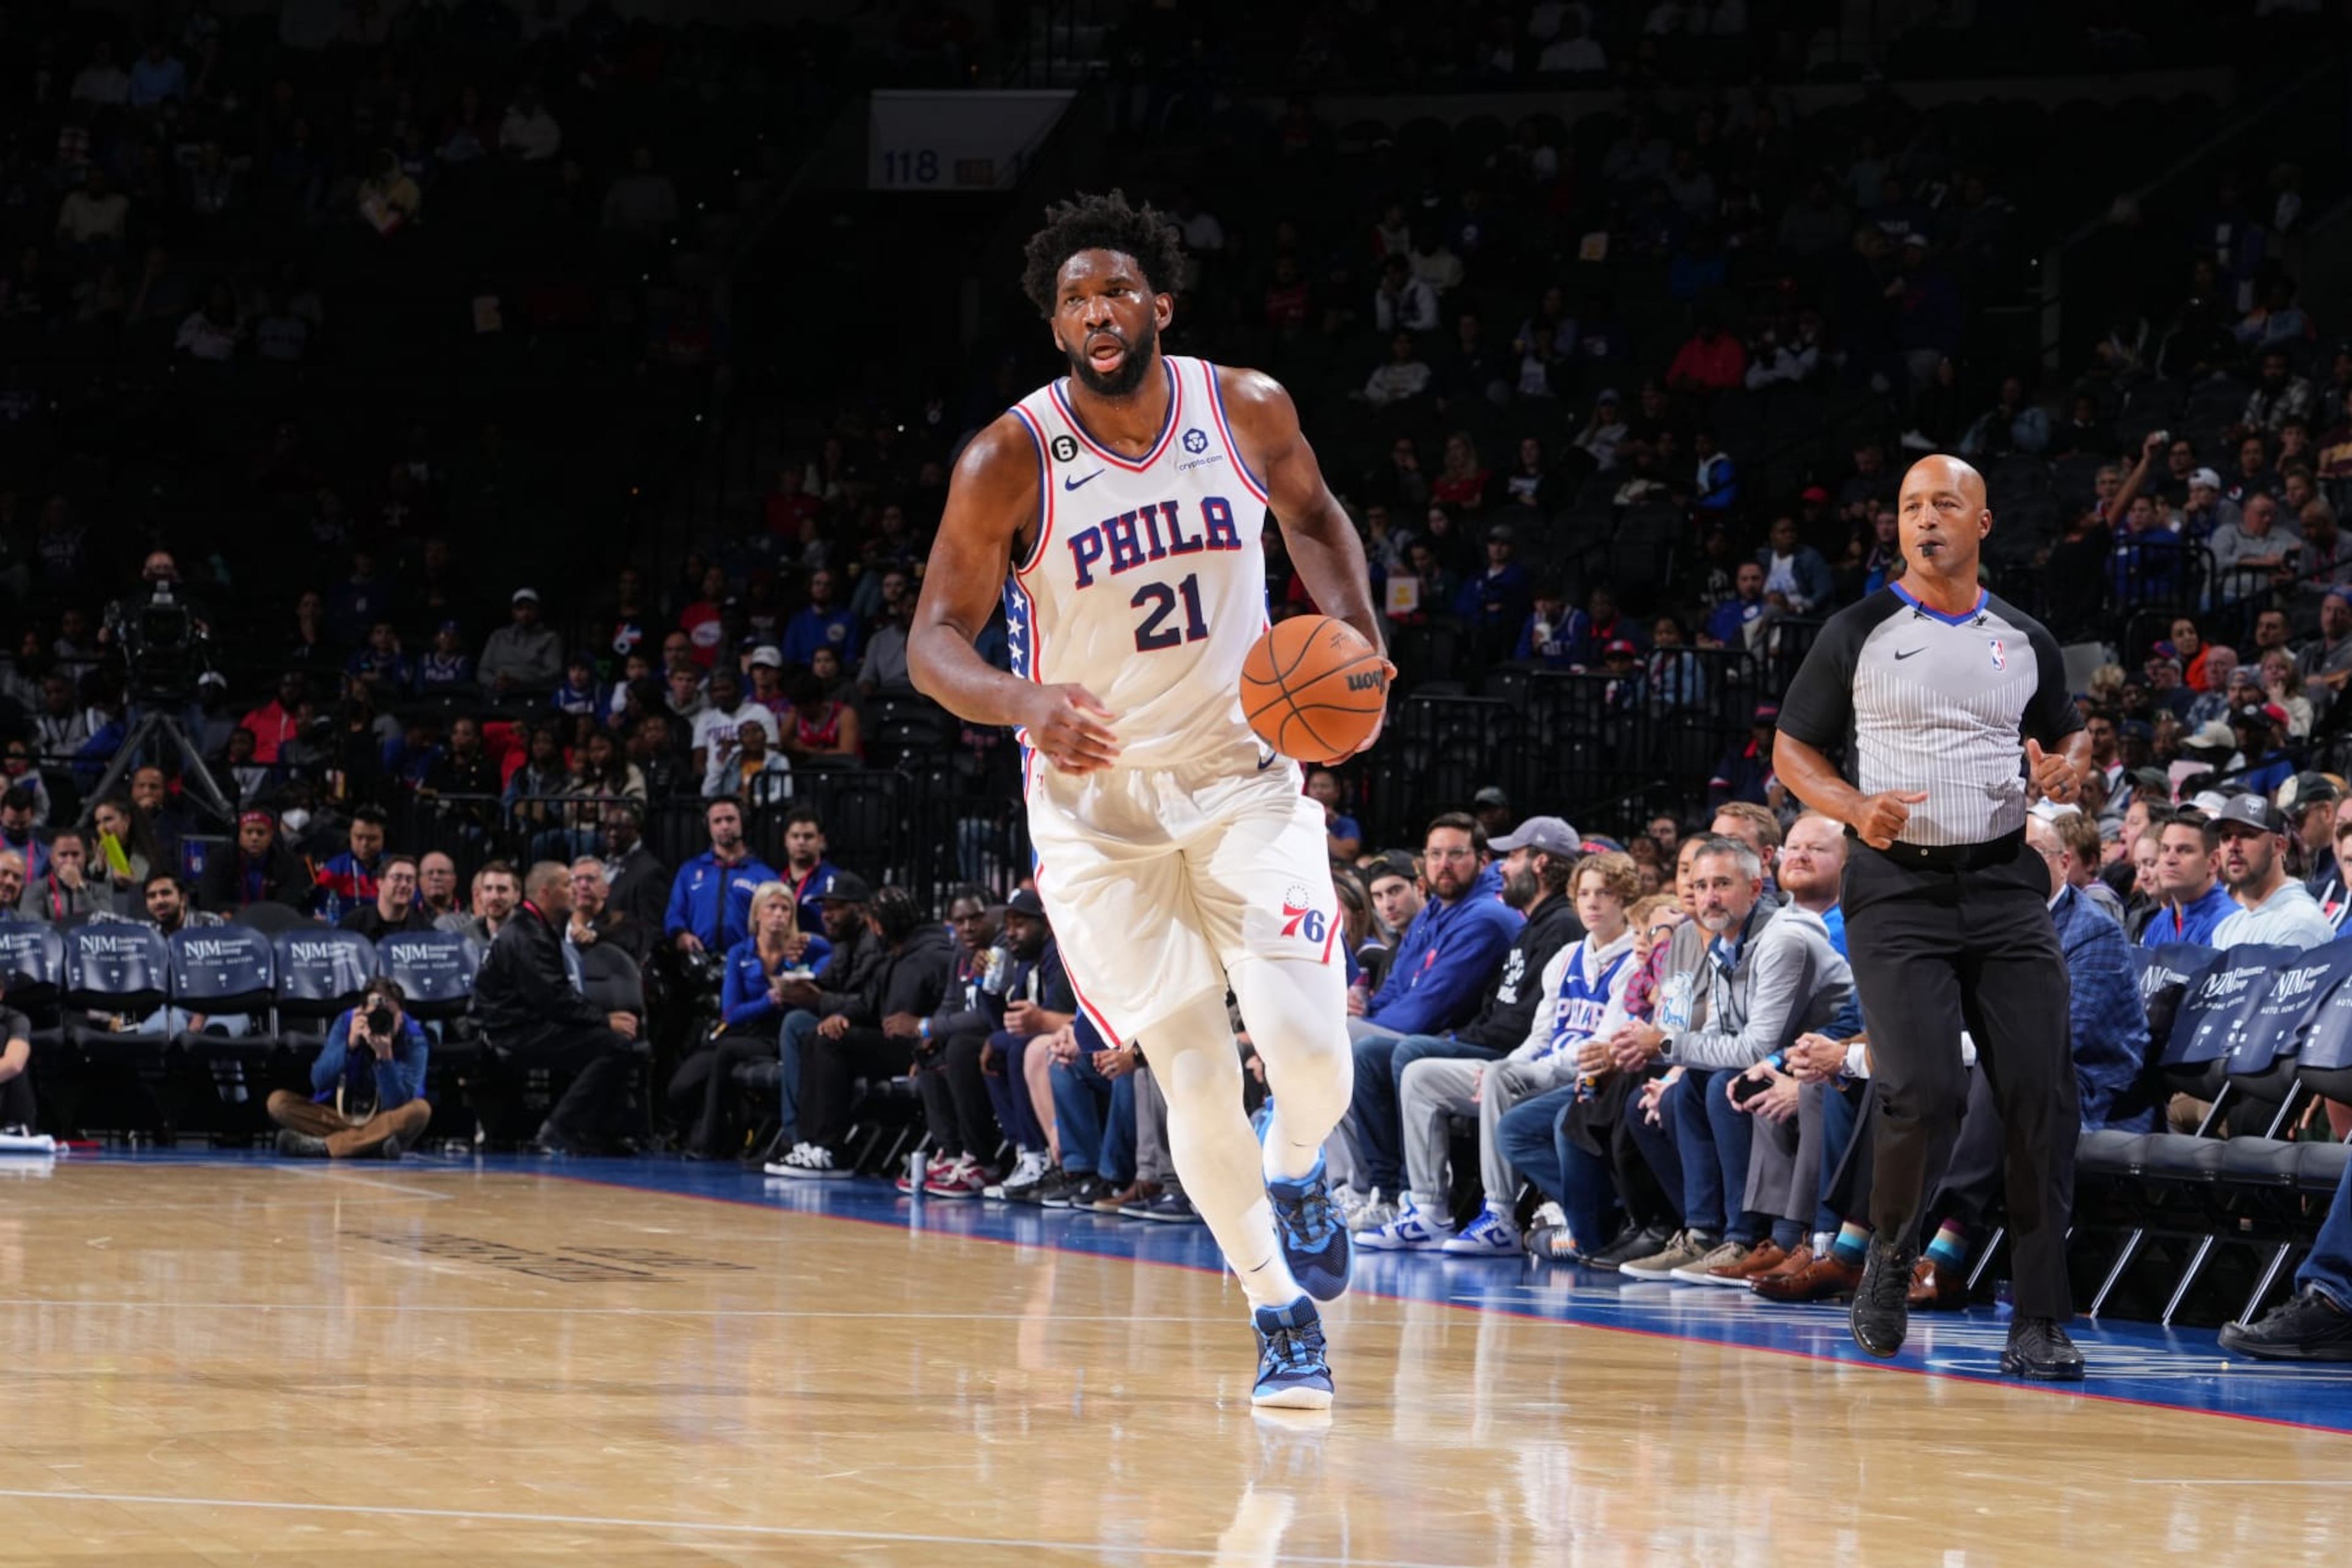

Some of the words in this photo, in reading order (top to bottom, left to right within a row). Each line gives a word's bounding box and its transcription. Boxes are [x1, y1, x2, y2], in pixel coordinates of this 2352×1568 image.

[884, 149, 939, 183] 118
[1056, 438, 1073, 460] 6
[1179, 454, 1223, 471] crypto.com
[1067, 497, 1242, 590] PHILA
[1130, 573, 1208, 653] 21
[1280, 902, 1325, 943] 76
[79, 935, 117, 954] NJM
[184, 939, 221, 961] NJM
[290, 941, 328, 962] NJM
[390, 943, 428, 963] NJM
[2268, 967, 2312, 1003] NJM
